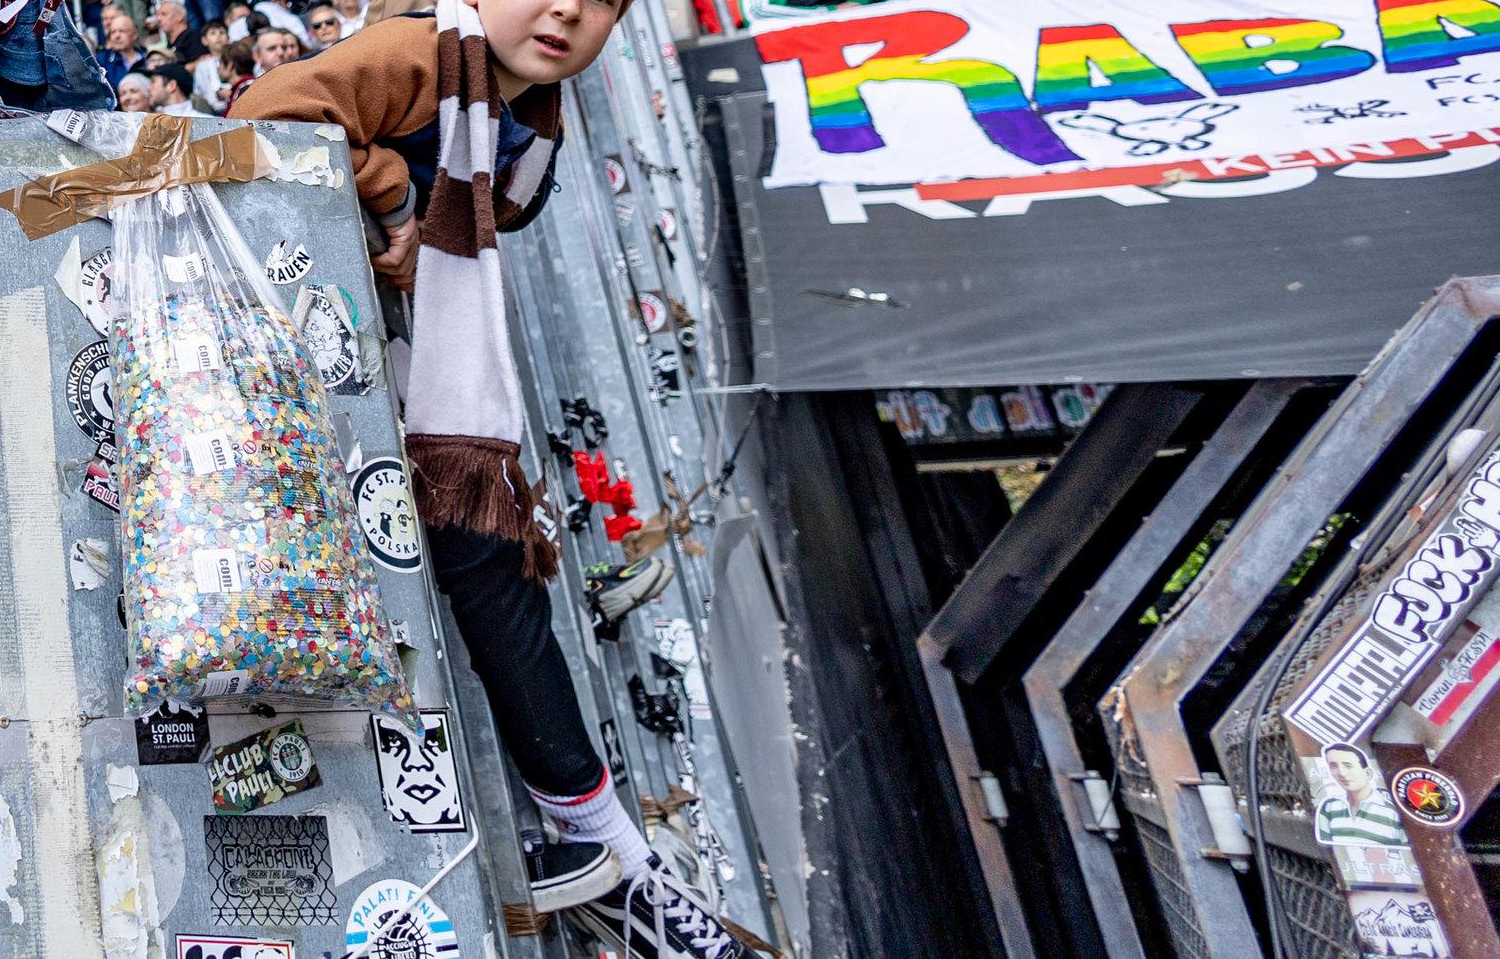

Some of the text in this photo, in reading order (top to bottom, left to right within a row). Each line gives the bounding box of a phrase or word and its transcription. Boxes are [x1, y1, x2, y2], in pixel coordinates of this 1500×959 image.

[328, 354, 352, 380] CLUB
[82, 369, 95, 400] GOOD
[85, 479, 120, 510] PAUL
[362, 482, 376, 503] FC
[375, 471, 395, 486] ST.
[369, 526, 418, 554] POLSKA
[1373, 534, 1492, 643] FUCK
[151, 723, 194, 733] LONDON
[225, 770, 276, 804] PAULI
[288, 769, 304, 778] 1910
[354, 888, 400, 927] PALATI
